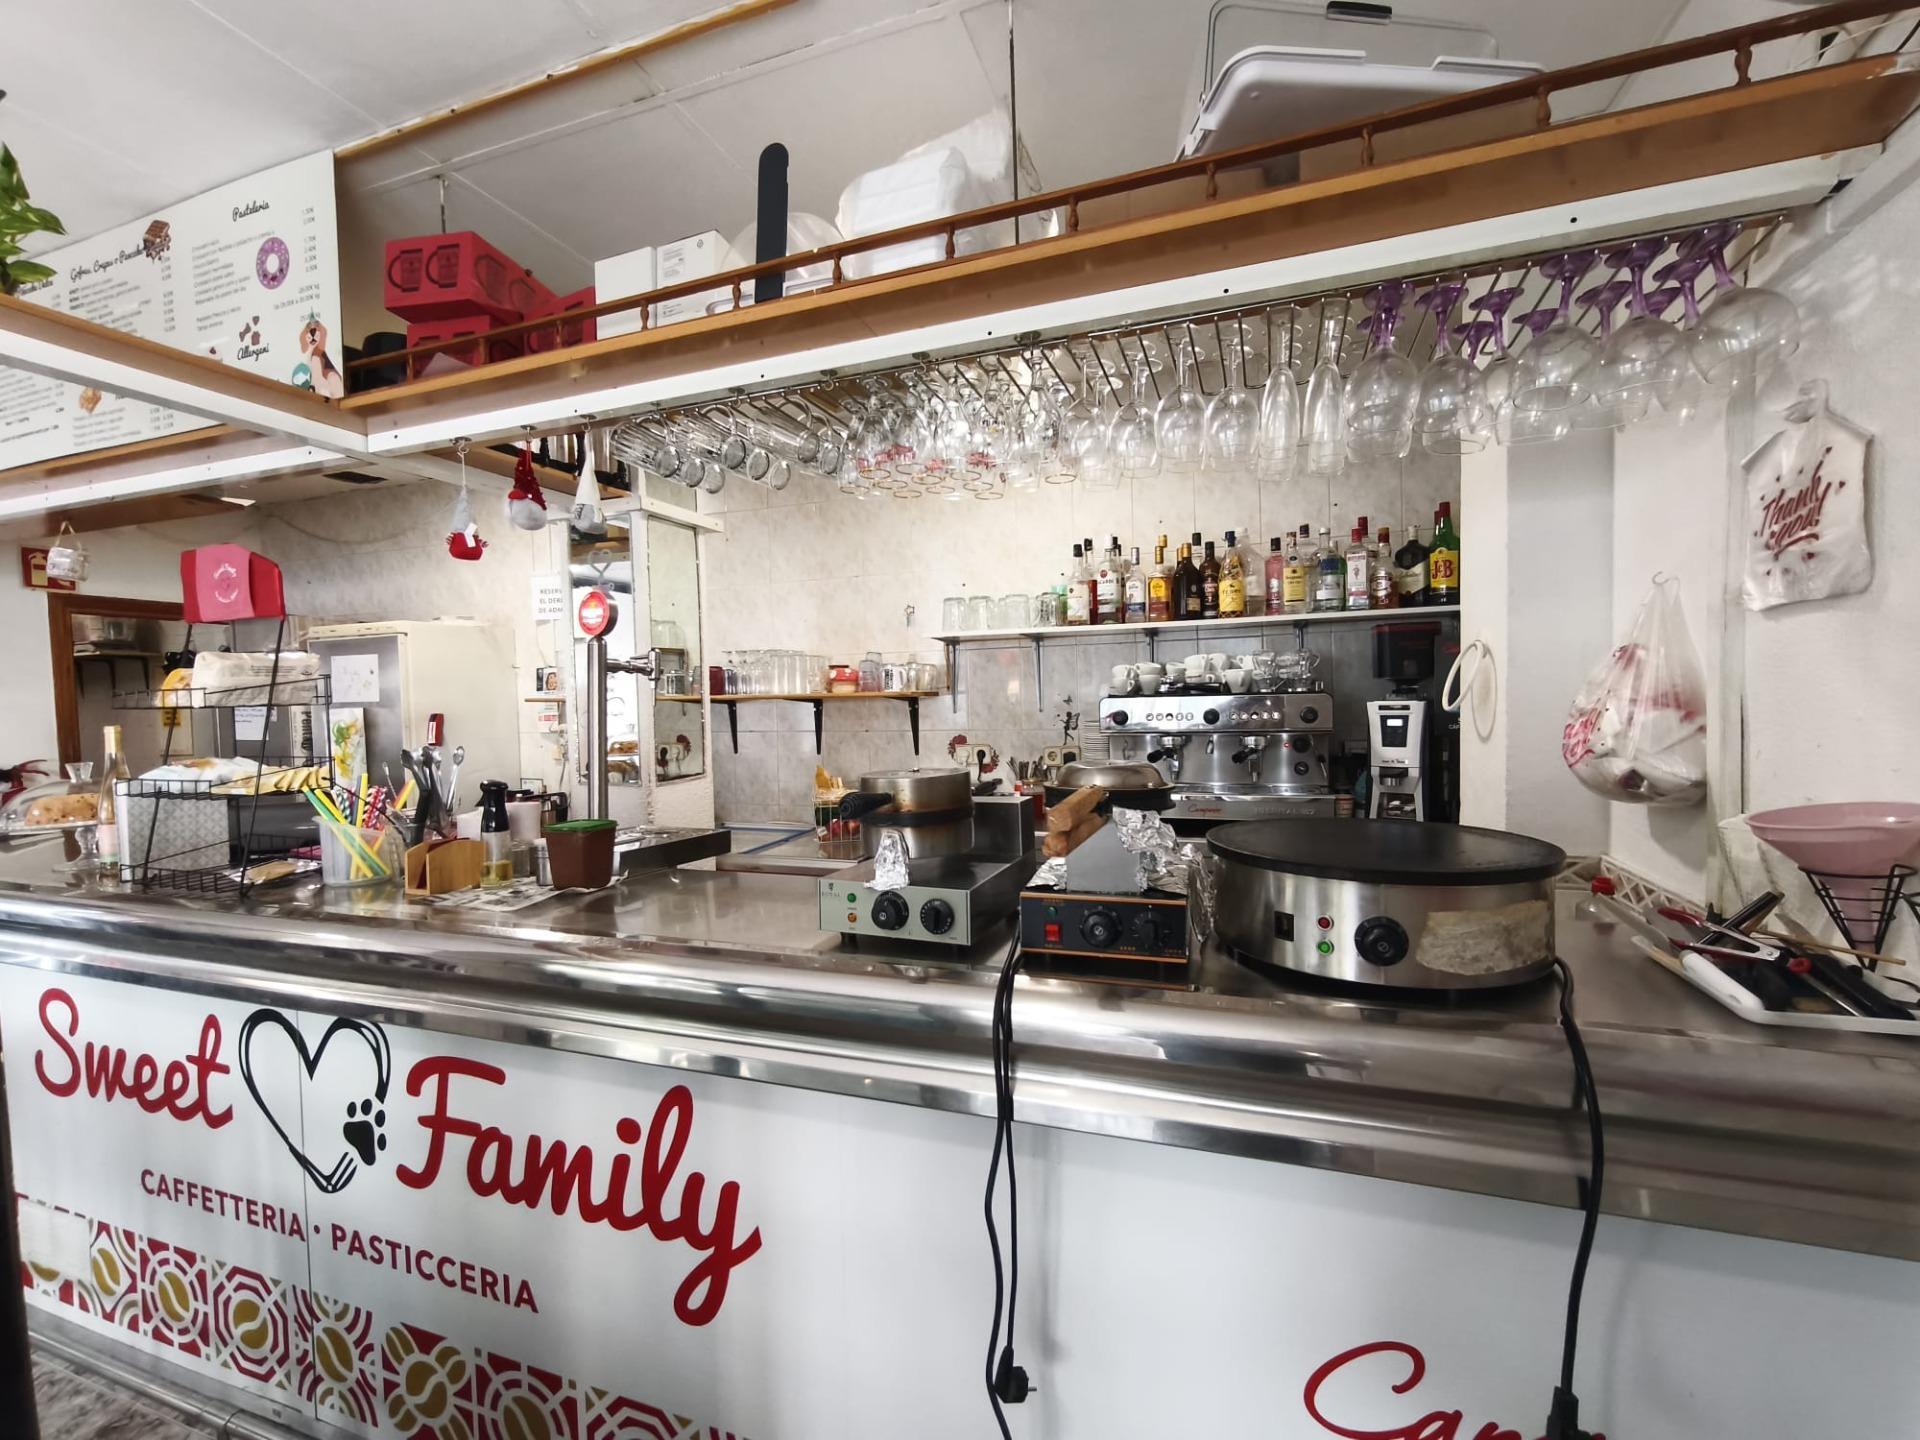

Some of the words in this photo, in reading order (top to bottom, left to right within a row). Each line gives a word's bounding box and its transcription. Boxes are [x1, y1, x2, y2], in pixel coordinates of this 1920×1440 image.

[34, 988, 234, 1129] Sweet
[141, 1169, 306, 1242] CAFFETTERIA
[331, 1222, 539, 1315] PASTICCERIA
[396, 1056, 763, 1327] Family
